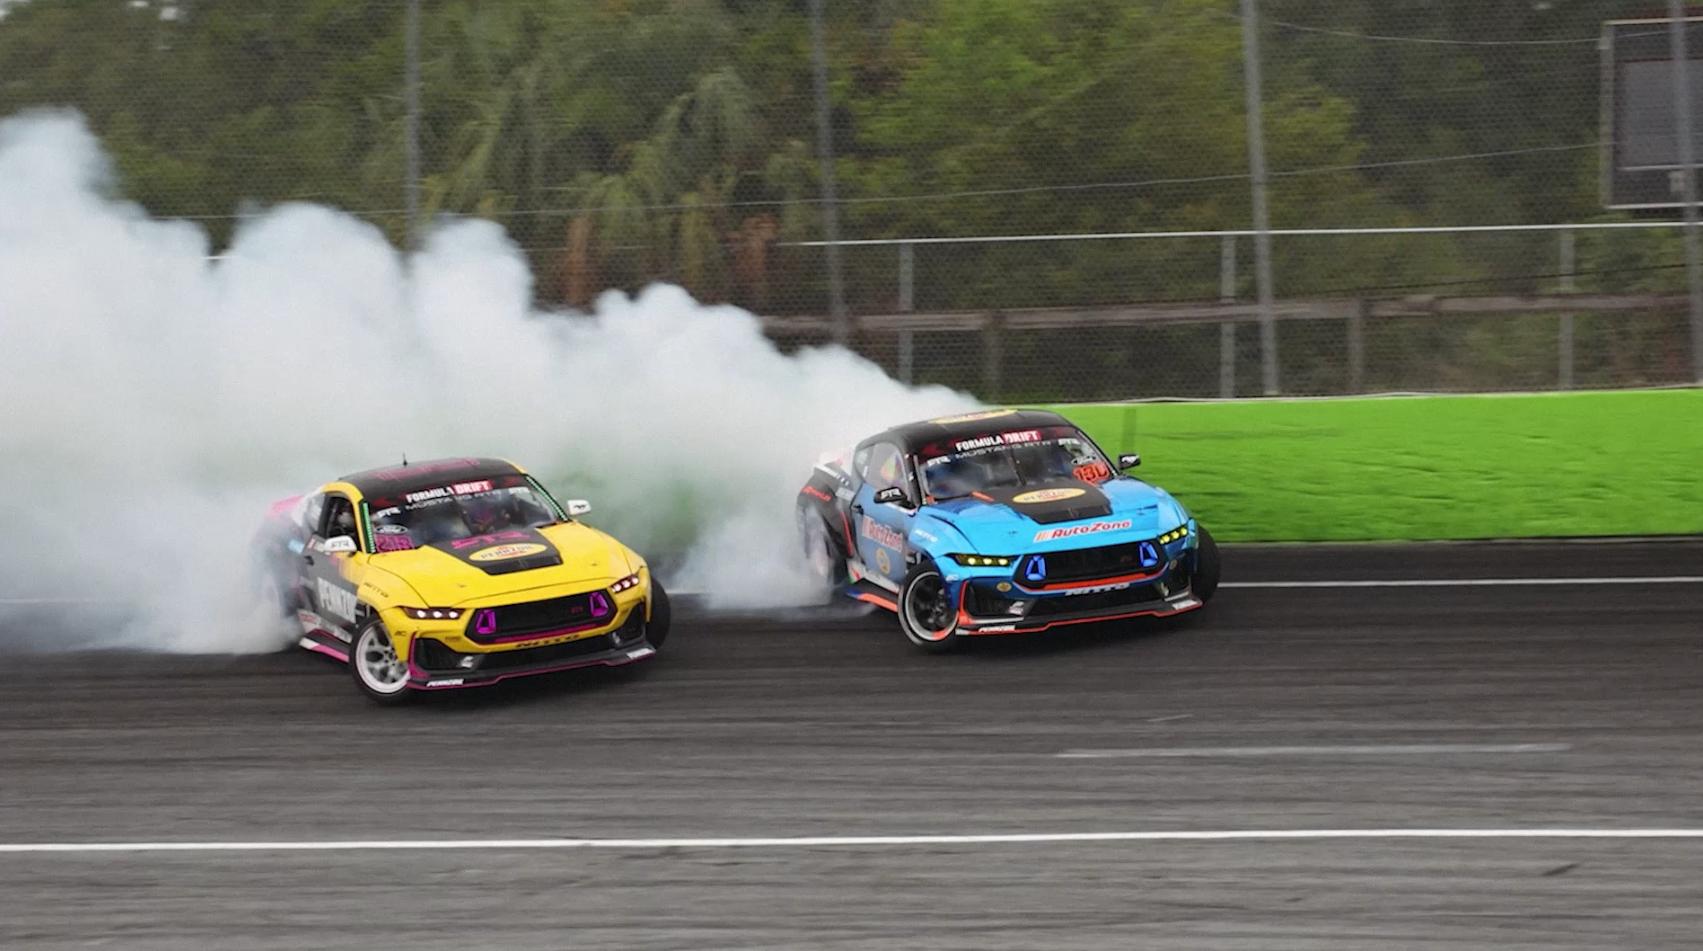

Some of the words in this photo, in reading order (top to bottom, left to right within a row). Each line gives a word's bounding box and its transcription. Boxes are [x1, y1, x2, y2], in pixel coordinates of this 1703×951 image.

[955, 435, 1004, 451] FORMULA
[1003, 431, 1039, 444] DRIFT
[405, 486, 454, 503] FORMULA
[453, 480, 490, 495] DRIFT
[1052, 520, 1130, 538] AutoZone
